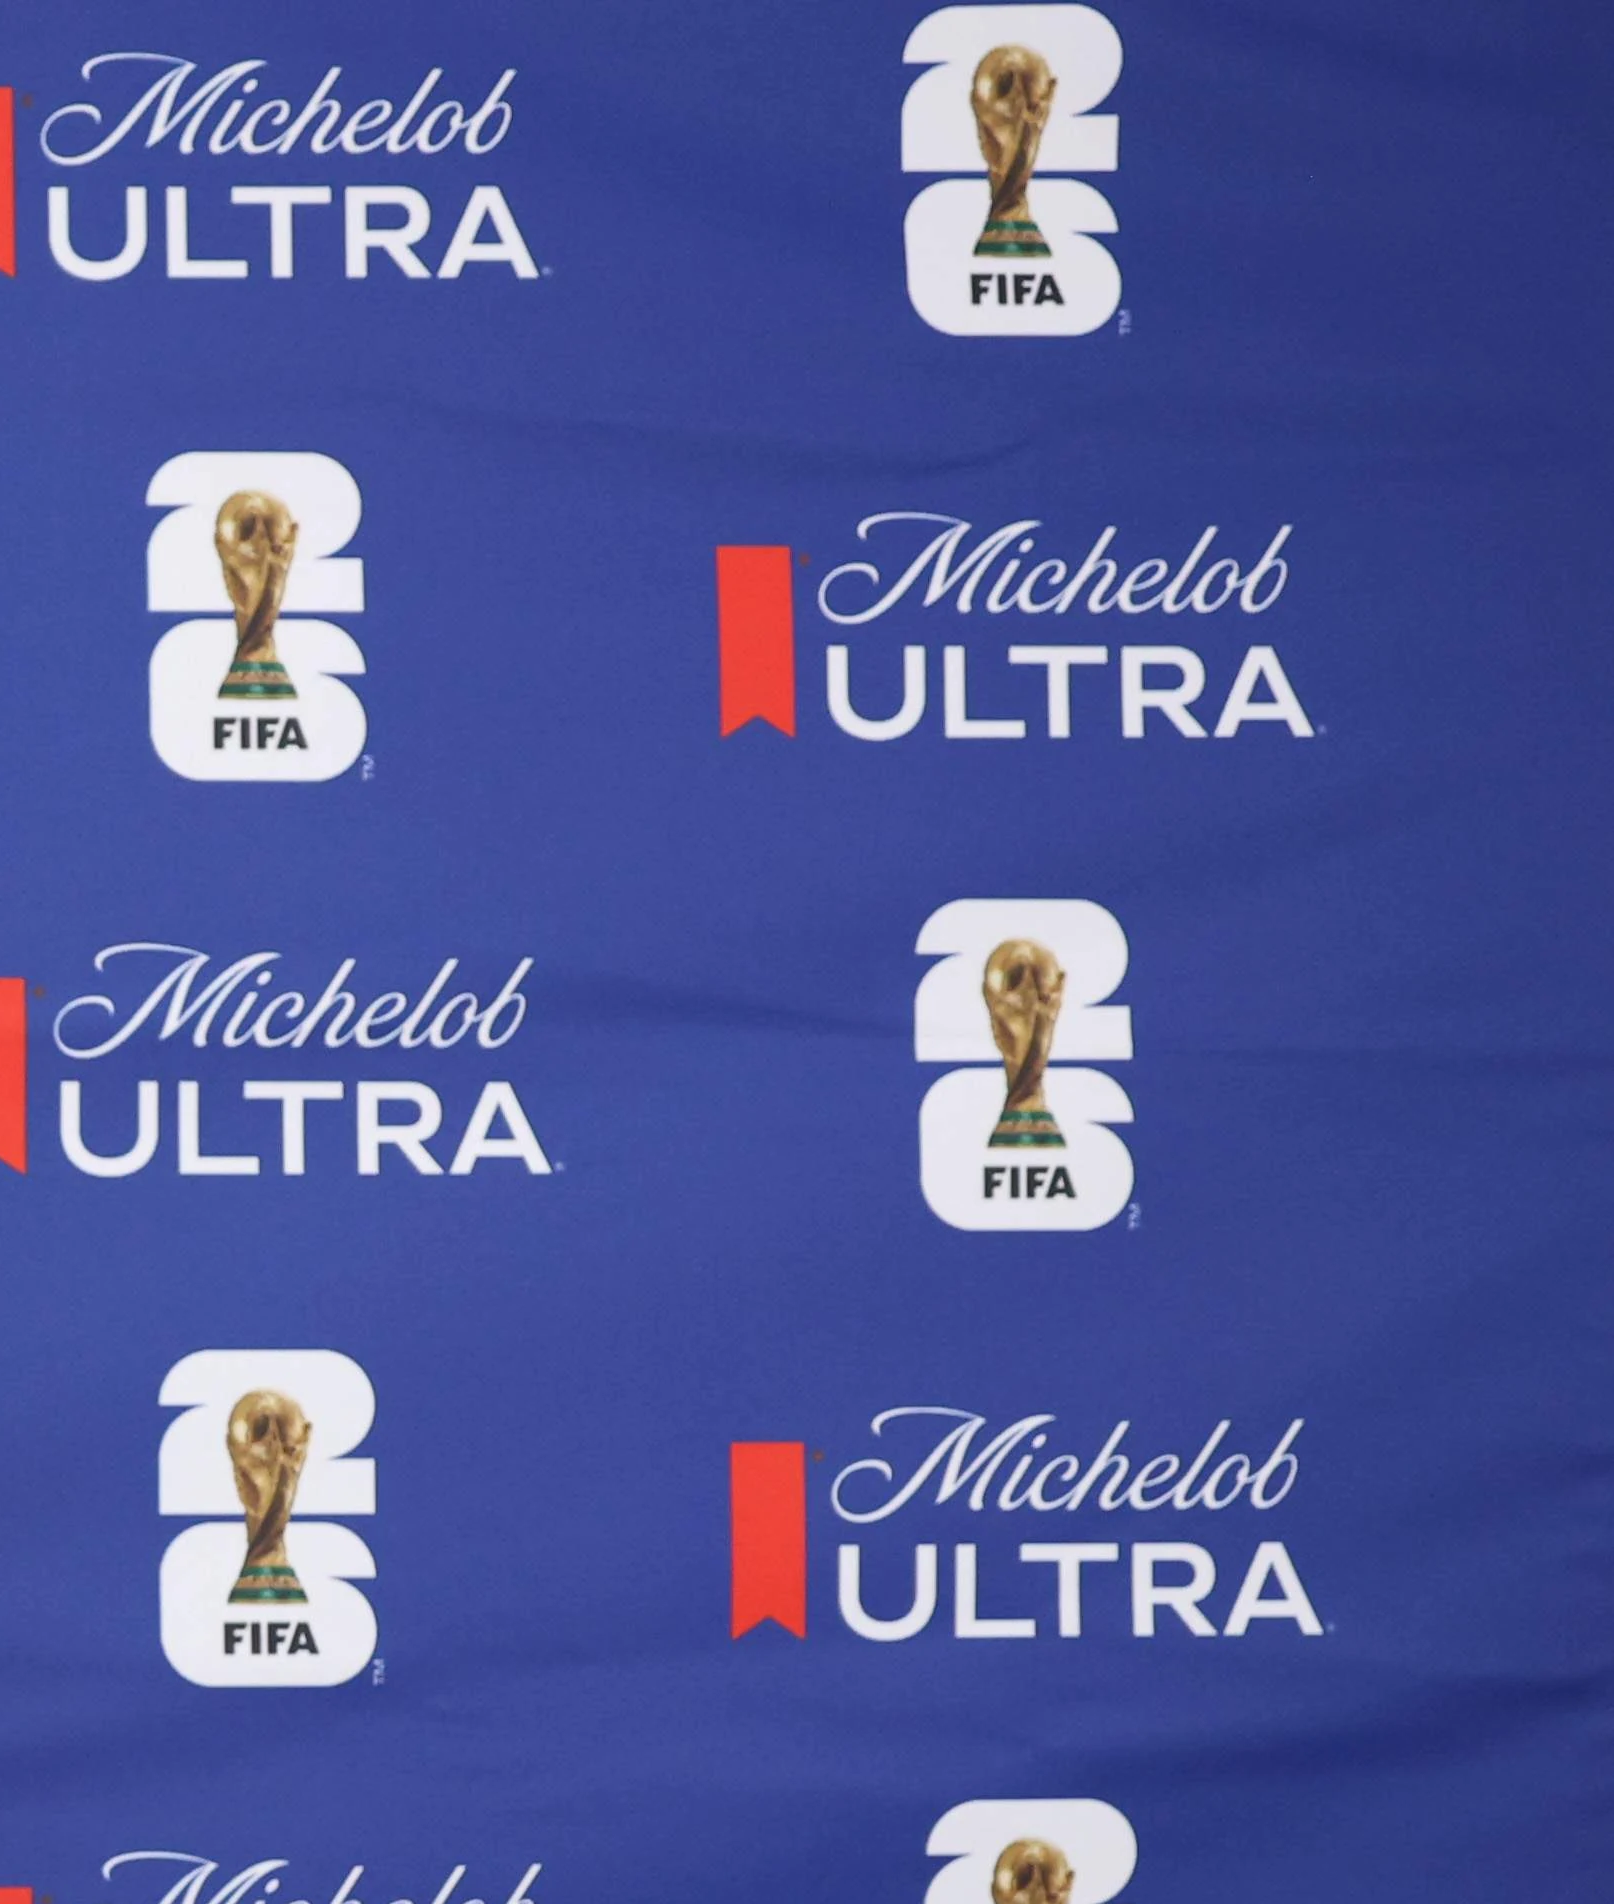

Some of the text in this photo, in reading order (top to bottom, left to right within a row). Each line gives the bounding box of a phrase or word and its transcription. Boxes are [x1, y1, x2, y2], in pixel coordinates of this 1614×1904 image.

[39, 51, 517, 168] Michelob
[46, 184, 540, 284] ULTRA
[970, 273, 1065, 306] FIFA
[817, 511, 1293, 626] Michelob
[213, 717, 308, 750] FIFA
[825, 644, 1316, 743] ULTRA
[52, 941, 534, 1061] Michelob
[58, 1078, 554, 1179] ULTRA
[983, 1166, 1077, 1199] FIFA
[829, 1406, 1305, 1525] Michelob
[223, 1621, 319, 1655] FIFA
[836, 1540, 1325, 1643] ULTRA
